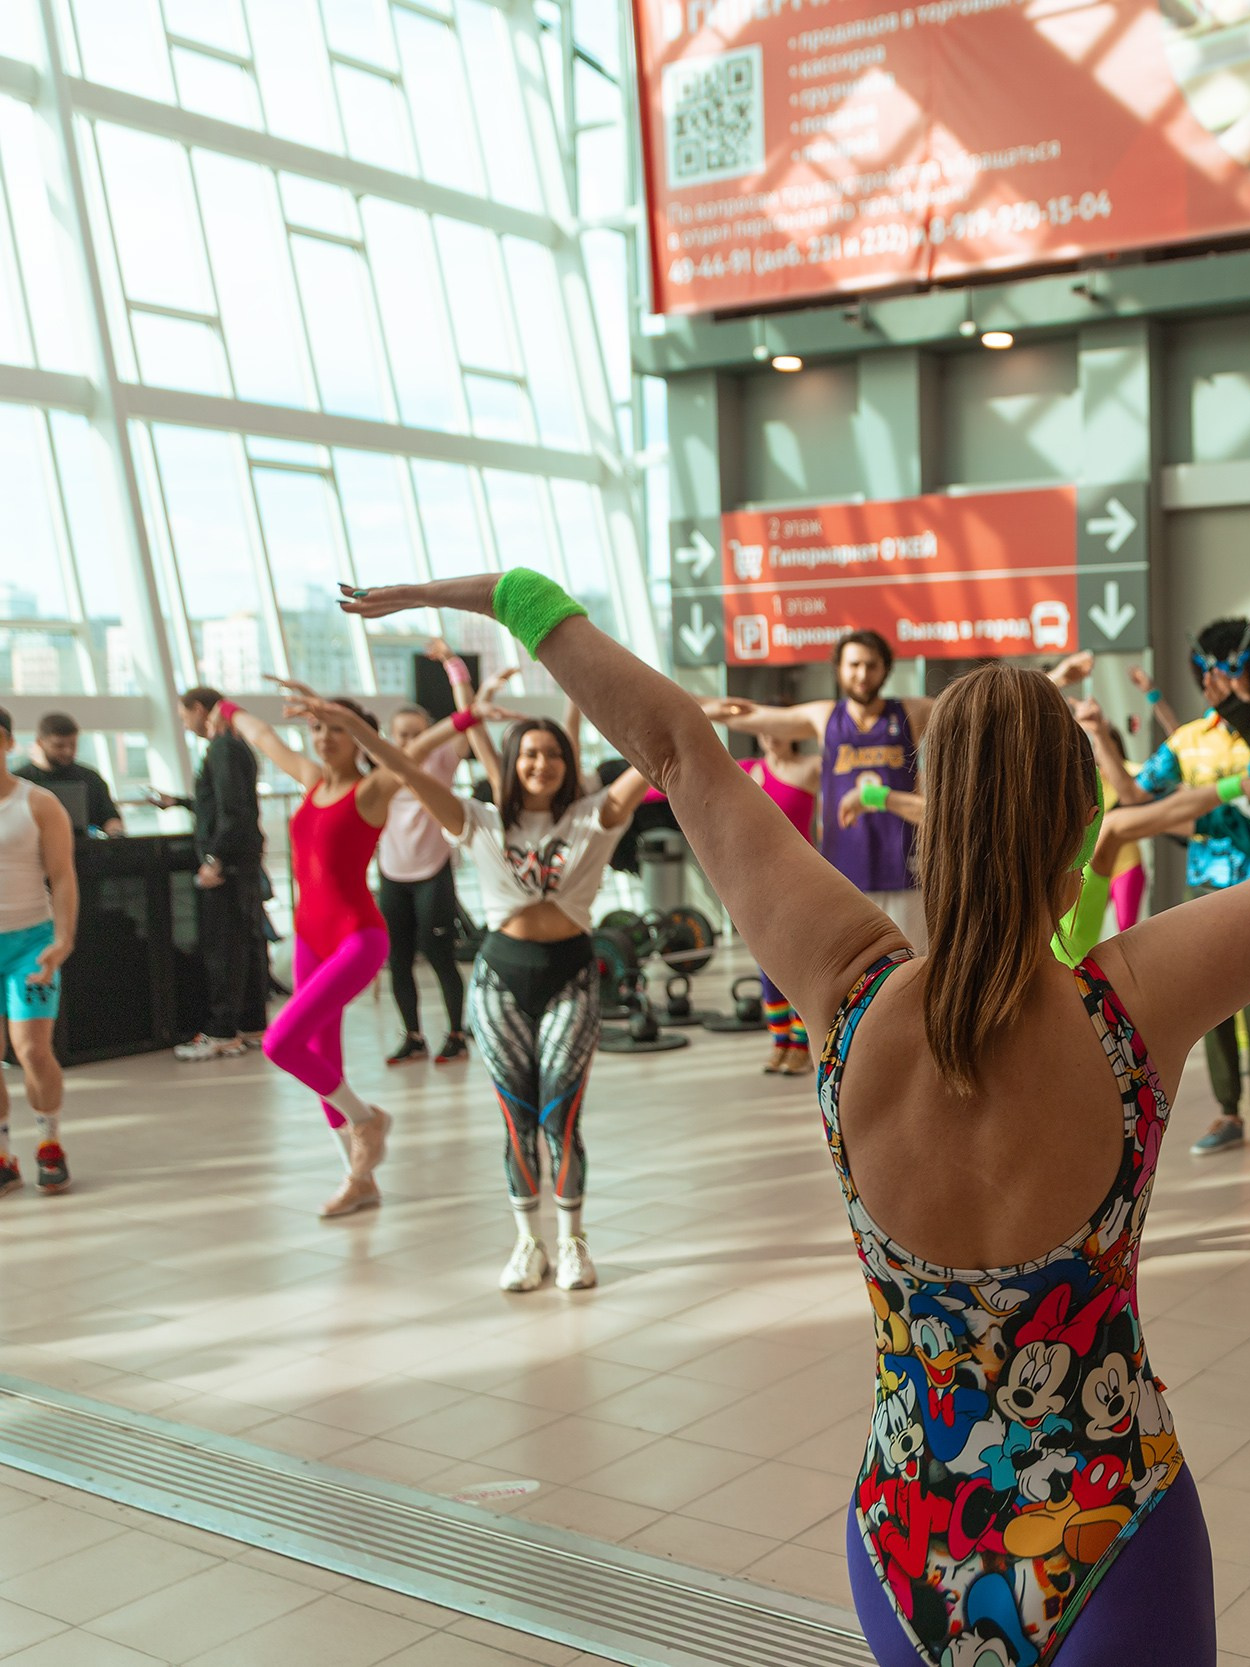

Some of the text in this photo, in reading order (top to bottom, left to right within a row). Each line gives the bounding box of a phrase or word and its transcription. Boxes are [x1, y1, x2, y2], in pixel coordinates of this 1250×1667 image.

[768, 516, 823, 541] 2 этаж
[769, 543, 879, 570] Гипермаркет
[773, 594, 827, 617] 1 этаж
[896, 618, 959, 643] Выход
[974, 617, 1031, 643] город
